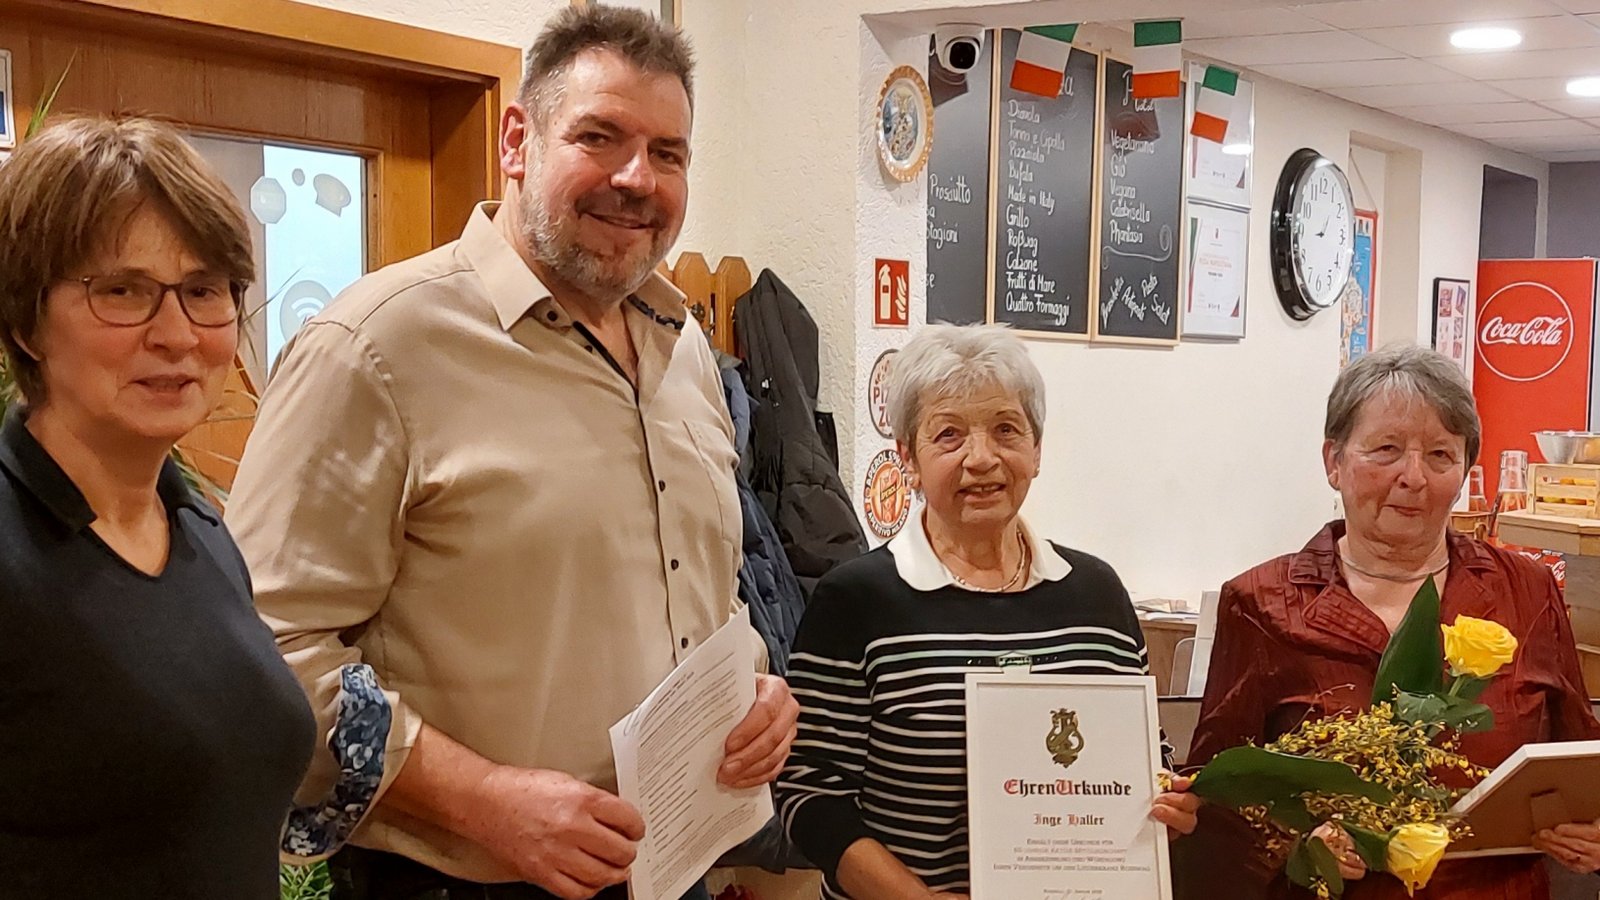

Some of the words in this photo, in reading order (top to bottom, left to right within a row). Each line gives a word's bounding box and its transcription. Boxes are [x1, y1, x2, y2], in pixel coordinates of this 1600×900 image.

[1008, 160, 1034, 186] Bufala
[1310, 183, 1318, 201] 11
[1319, 177, 1328, 195] 12
[1007, 184, 1026, 203] Made
[1028, 188, 1037, 205] in
[1039, 189, 1056, 216] Italy
[1006, 204, 1030, 228] Grillo
[1303, 202, 1312, 220] 10
[1336, 203, 1344, 219] 2
[1339, 228, 1345, 246] 3
[1006, 250, 1038, 272] Calzone
[1334, 252, 1340, 269] 4
[1006, 271, 1027, 289] Frutti
[1028, 273, 1036, 291] di
[1037, 274, 1055, 293] Mare
[1307, 266, 1314, 284] 7
[1315, 274, 1322, 292] 6
[1327, 269, 1332, 291] 5
[1006, 291, 1034, 313] Quattro
[1034, 294, 1070, 326] Formaggi
[1481, 316, 1568, 345] Coca-Cola
[1003, 779, 1132, 797] EhrenUrkunde
[1033, 813, 1062, 826] Inge
[1067, 814, 1105, 826] Haller
